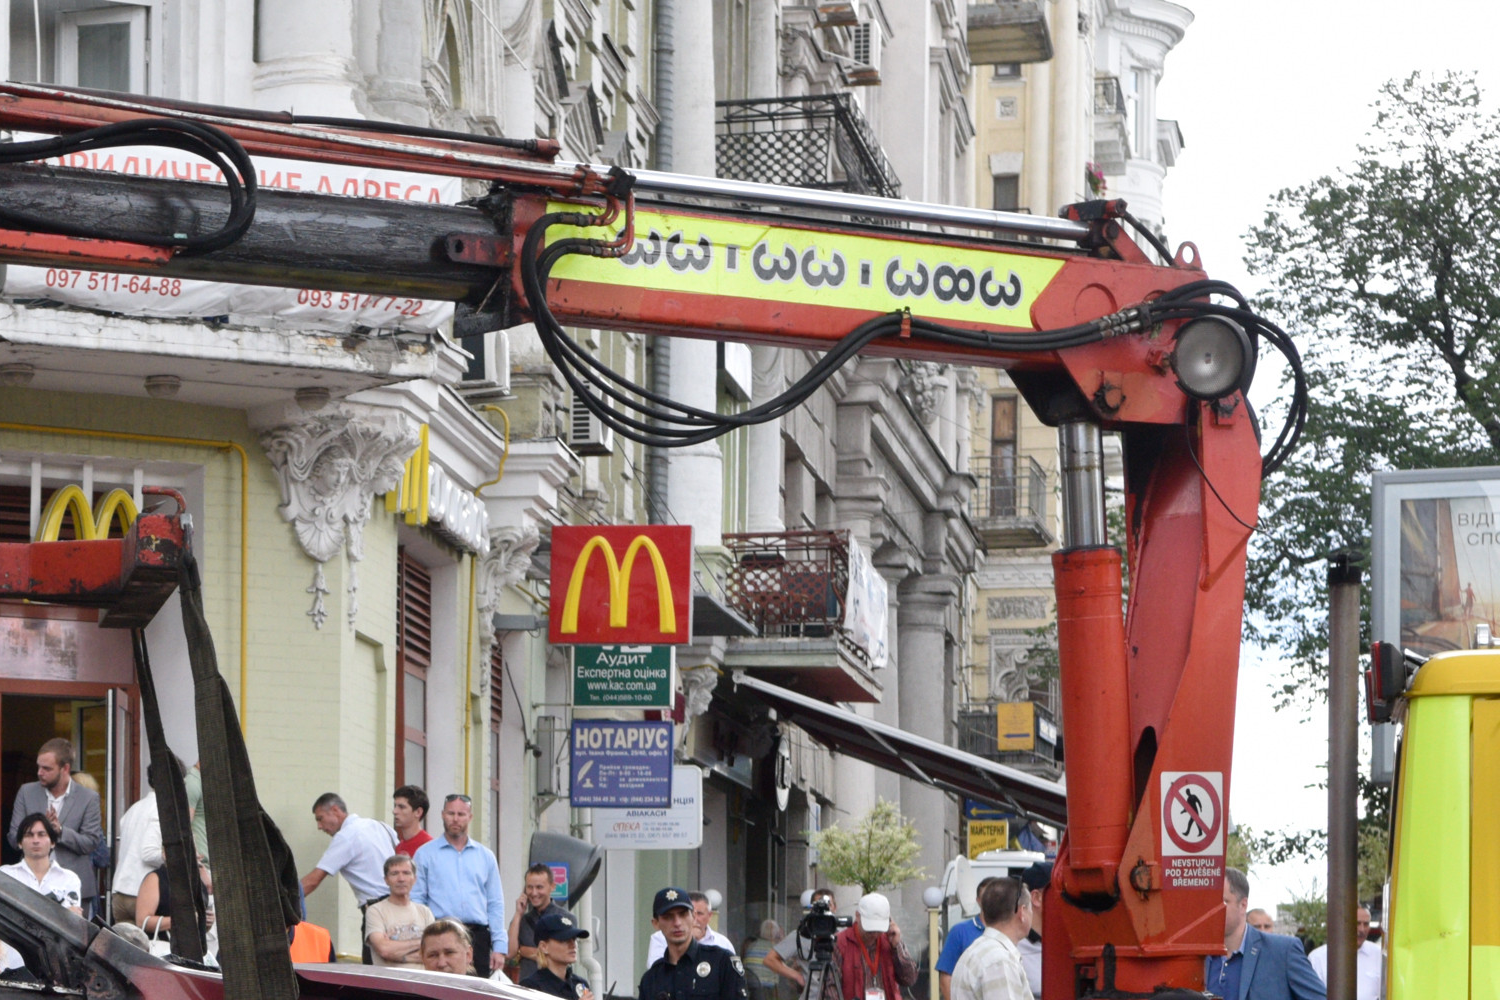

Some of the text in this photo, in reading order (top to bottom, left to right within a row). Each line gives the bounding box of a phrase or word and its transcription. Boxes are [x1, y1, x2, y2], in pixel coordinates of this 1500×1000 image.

[46, 268, 182, 297] 097 511-64-88
[297, 287, 332, 309] 093
[596, 652, 647, 666] Аудит
[577, 666, 667, 680] Експертна оцінка
[587, 681, 657, 690] www.kac.com.ua
[575, 727, 668, 749] НОТАРІУС
[1171, 858, 1215, 867] NEVSTUPUJ
[1165, 868, 1182, 877] POD
[1172, 877, 1210, 887] BŘEMENO
